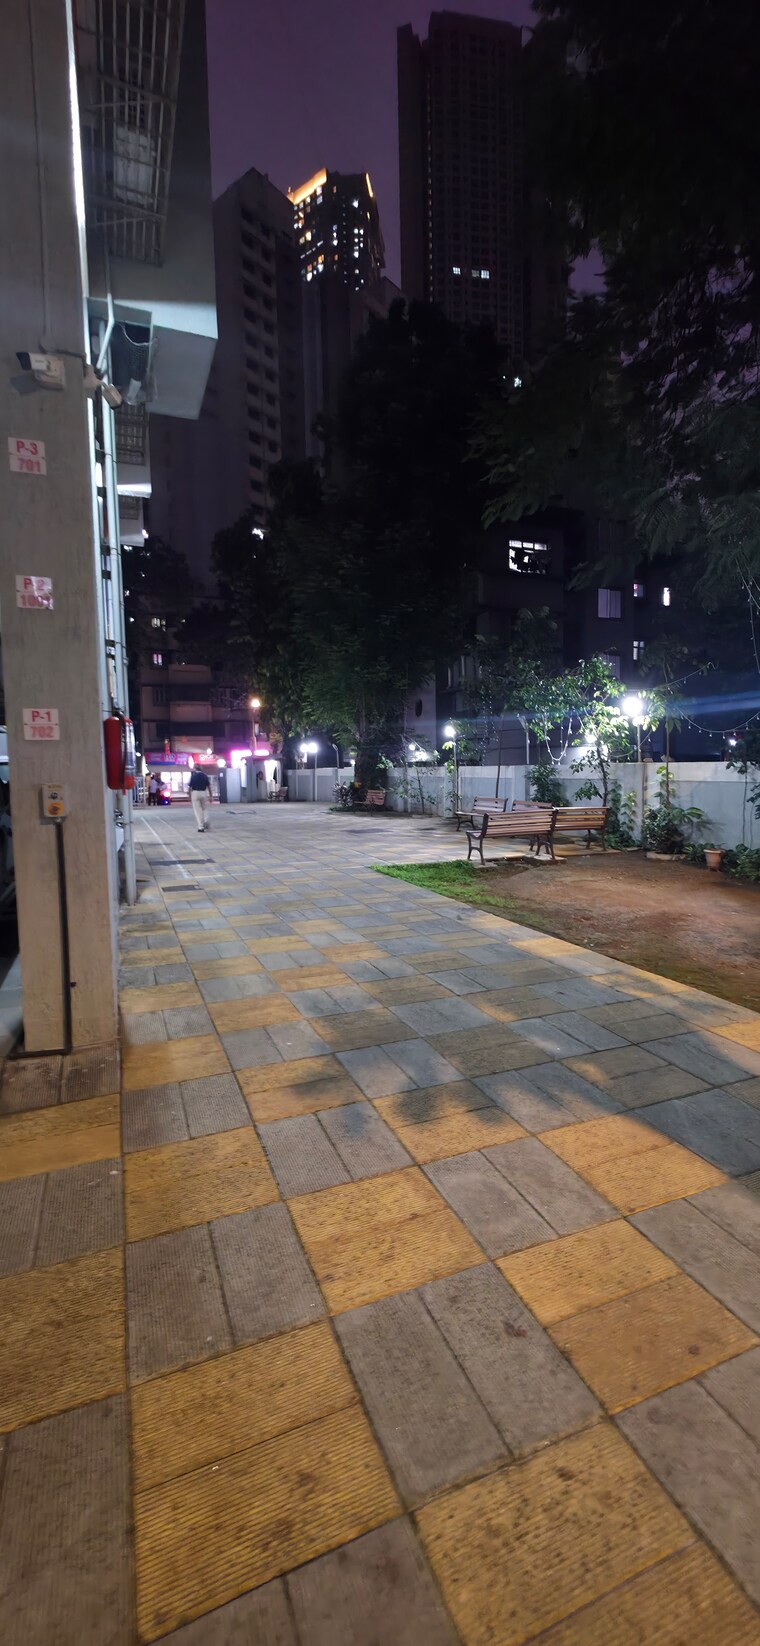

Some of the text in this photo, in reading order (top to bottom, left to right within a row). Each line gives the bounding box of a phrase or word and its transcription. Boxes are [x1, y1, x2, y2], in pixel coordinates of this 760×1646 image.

[16, 440, 39, 456] P-3
[18, 458, 41, 473] 701
[31, 710, 52, 722] P-1
[30, 726, 55, 738] 702
